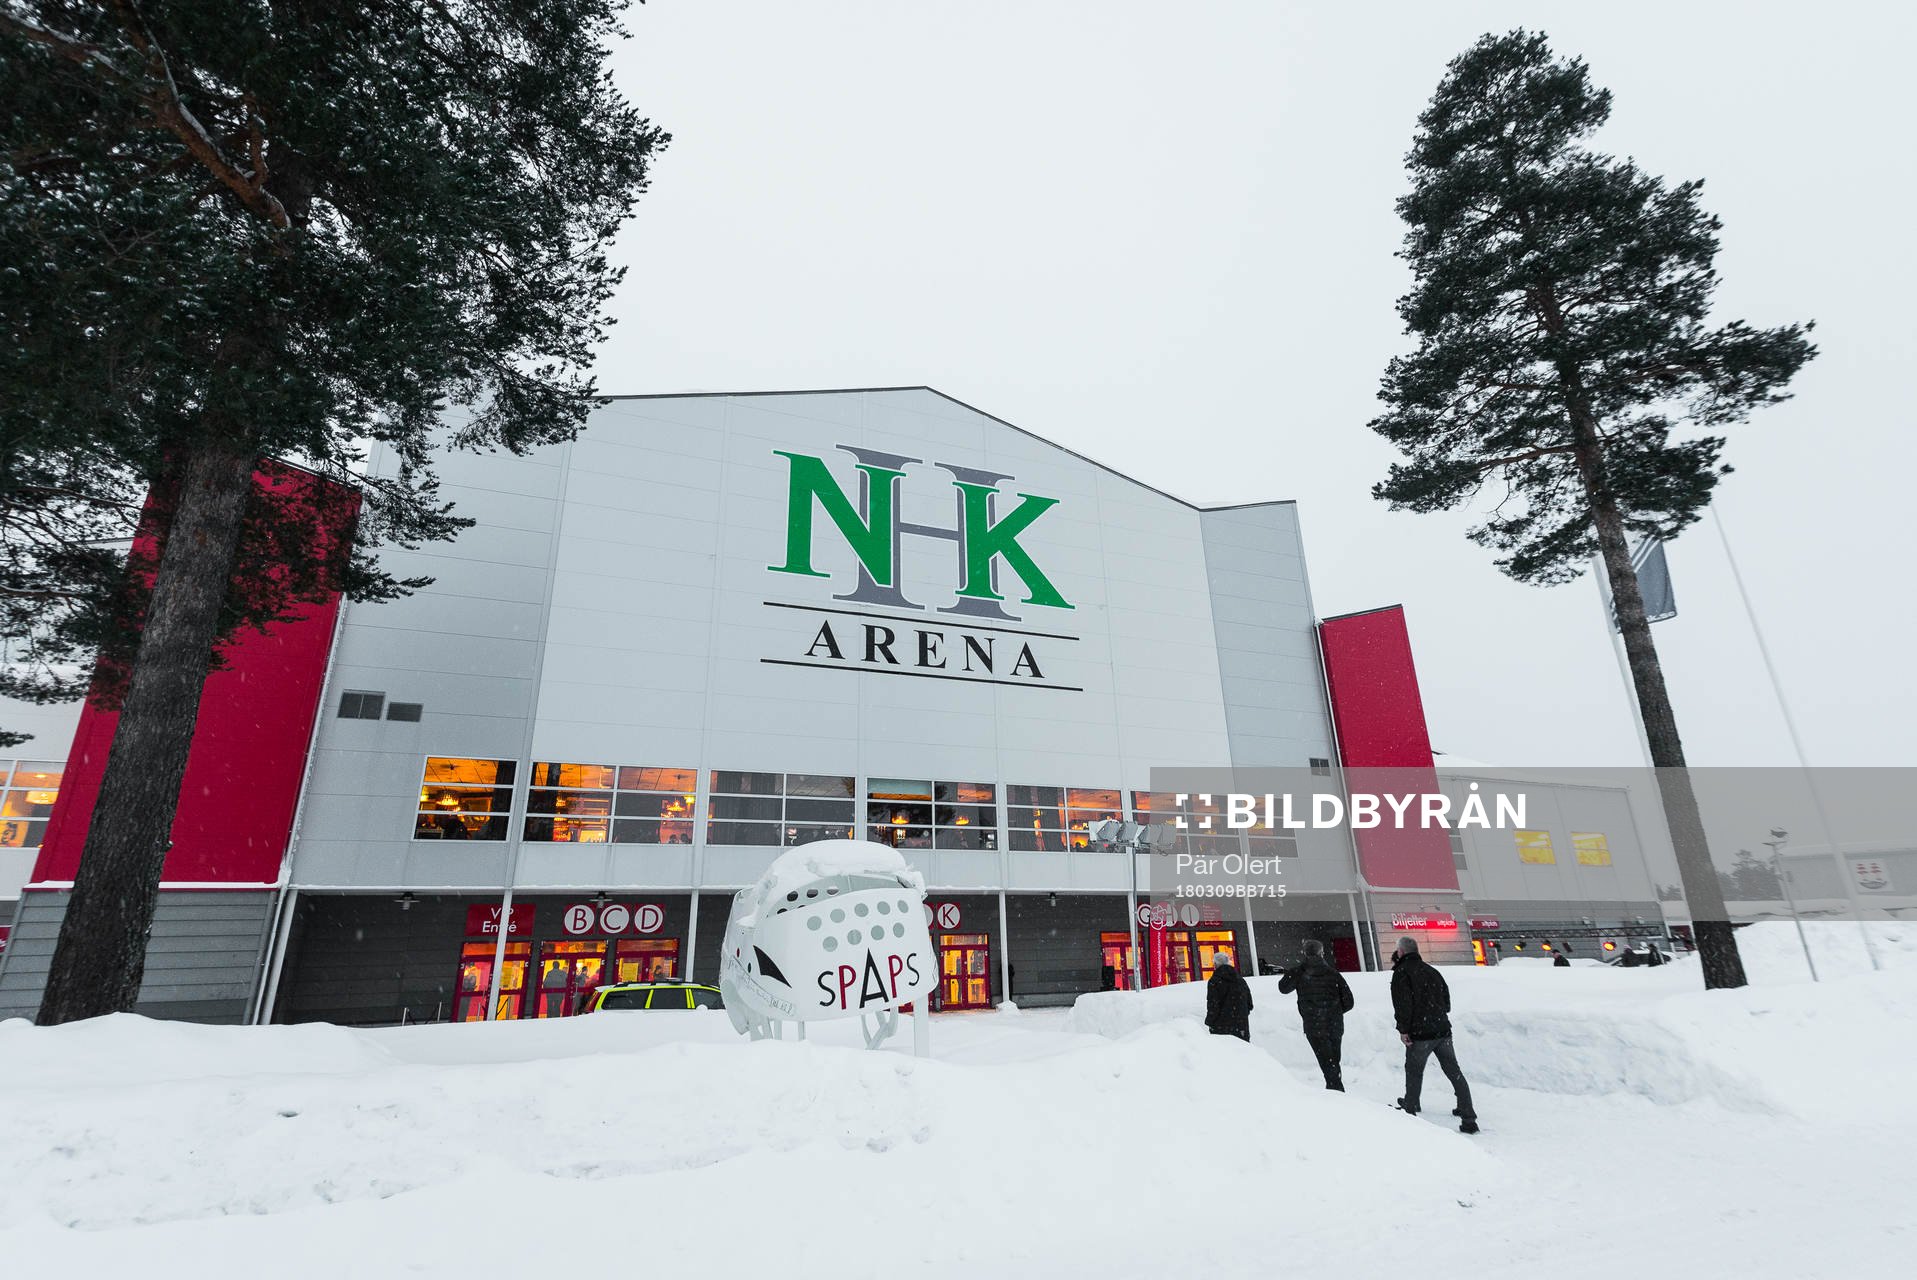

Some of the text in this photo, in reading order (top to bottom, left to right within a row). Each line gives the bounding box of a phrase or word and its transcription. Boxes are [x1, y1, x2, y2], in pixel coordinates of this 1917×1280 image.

[804, 620, 1045, 679] ARENA
[572, 907, 659, 931] B C D
[942, 906, 955, 926] K
[1391, 913, 1427, 929] Biljetter
[817, 948, 920, 1010] SPAPS
